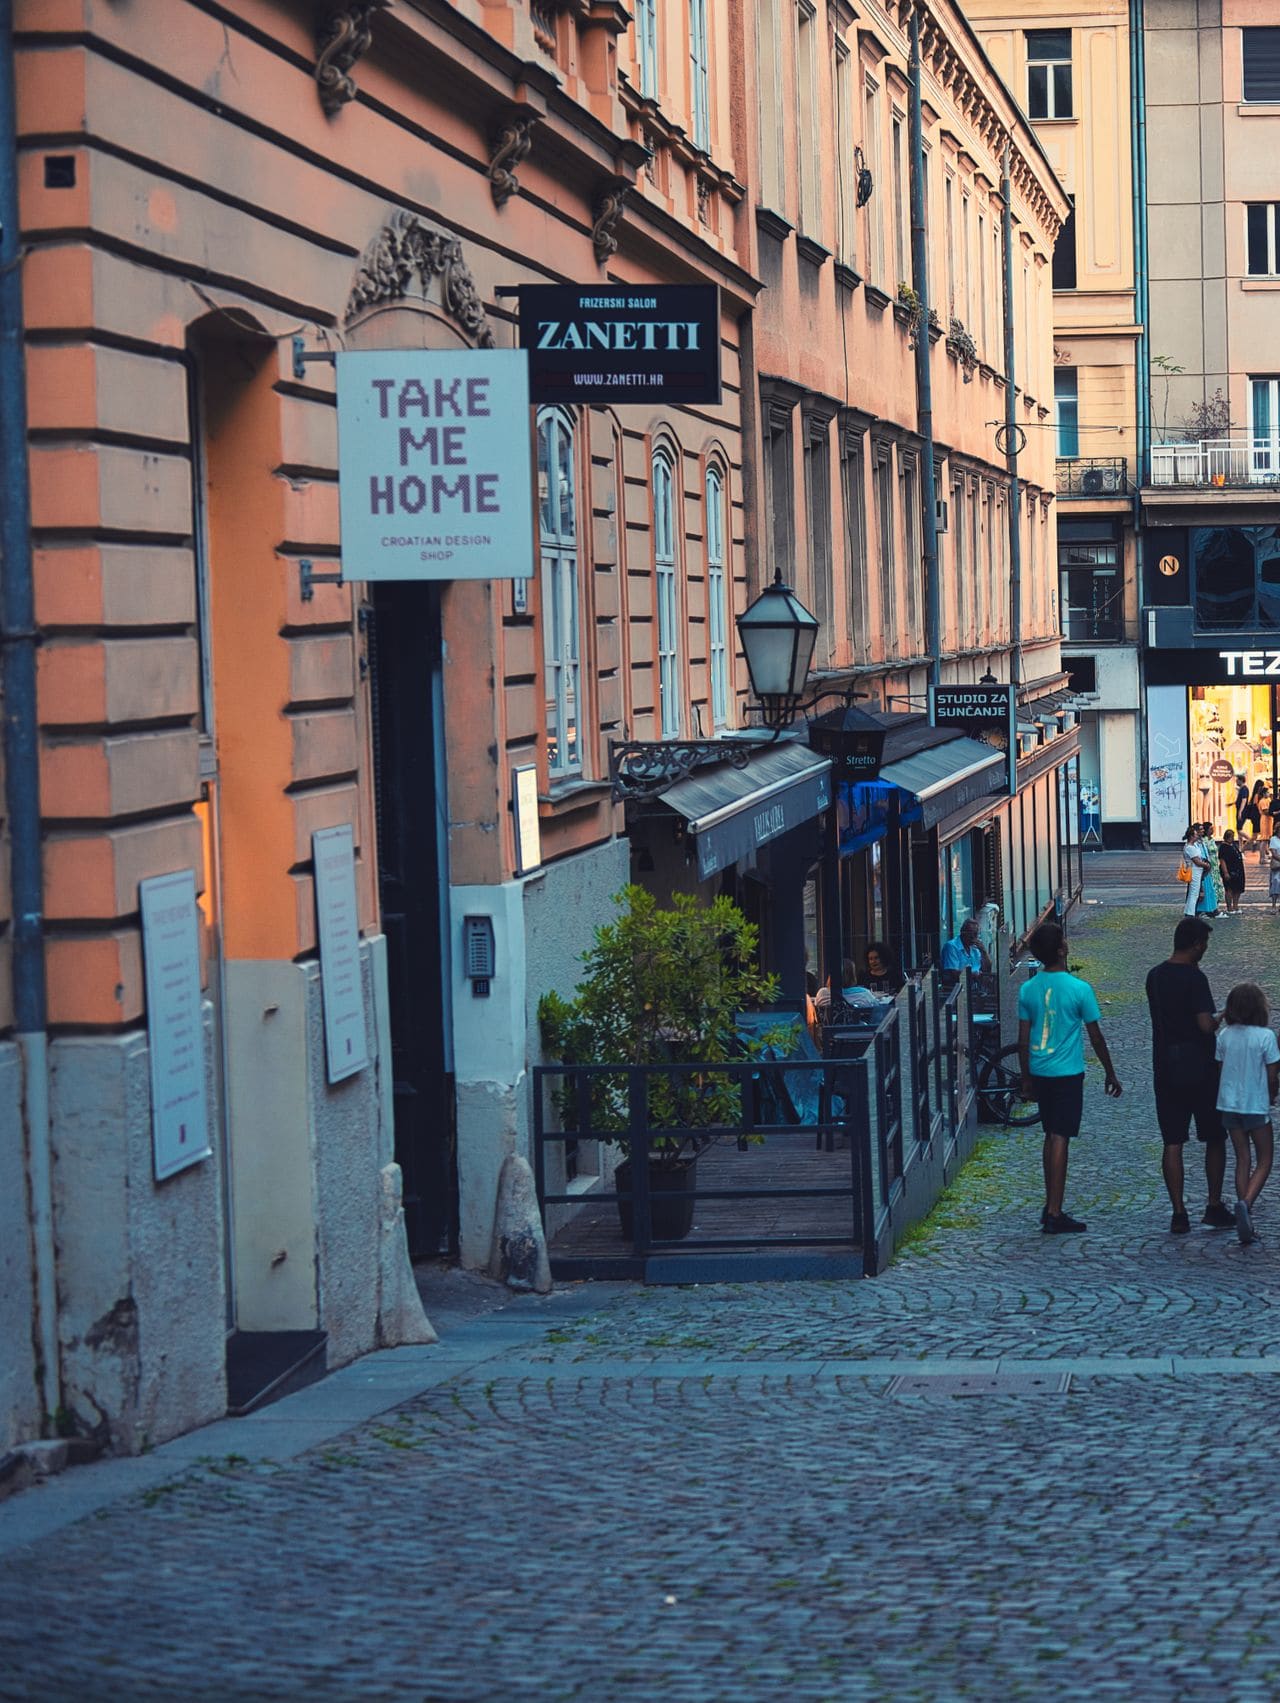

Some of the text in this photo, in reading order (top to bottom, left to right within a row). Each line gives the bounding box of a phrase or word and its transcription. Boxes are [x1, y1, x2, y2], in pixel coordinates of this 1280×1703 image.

[579, 297, 657, 309] FRIZERSKI SALON
[536, 321, 700, 350] ZANETTI
[573, 373, 664, 386] WWW.ZANETTI.HR
[371, 377, 491, 419] TAKE
[399, 426, 467, 466] ME
[370, 473, 500, 515] HOME
[381, 535, 491, 547] CROATIAN DESIGN
[420, 551, 454, 561] SHOP
[937, 694, 1008, 704] STUDIO ZA
[937, 706, 1006, 717] SUNČANJE
[846, 755, 876, 765] Stretto
